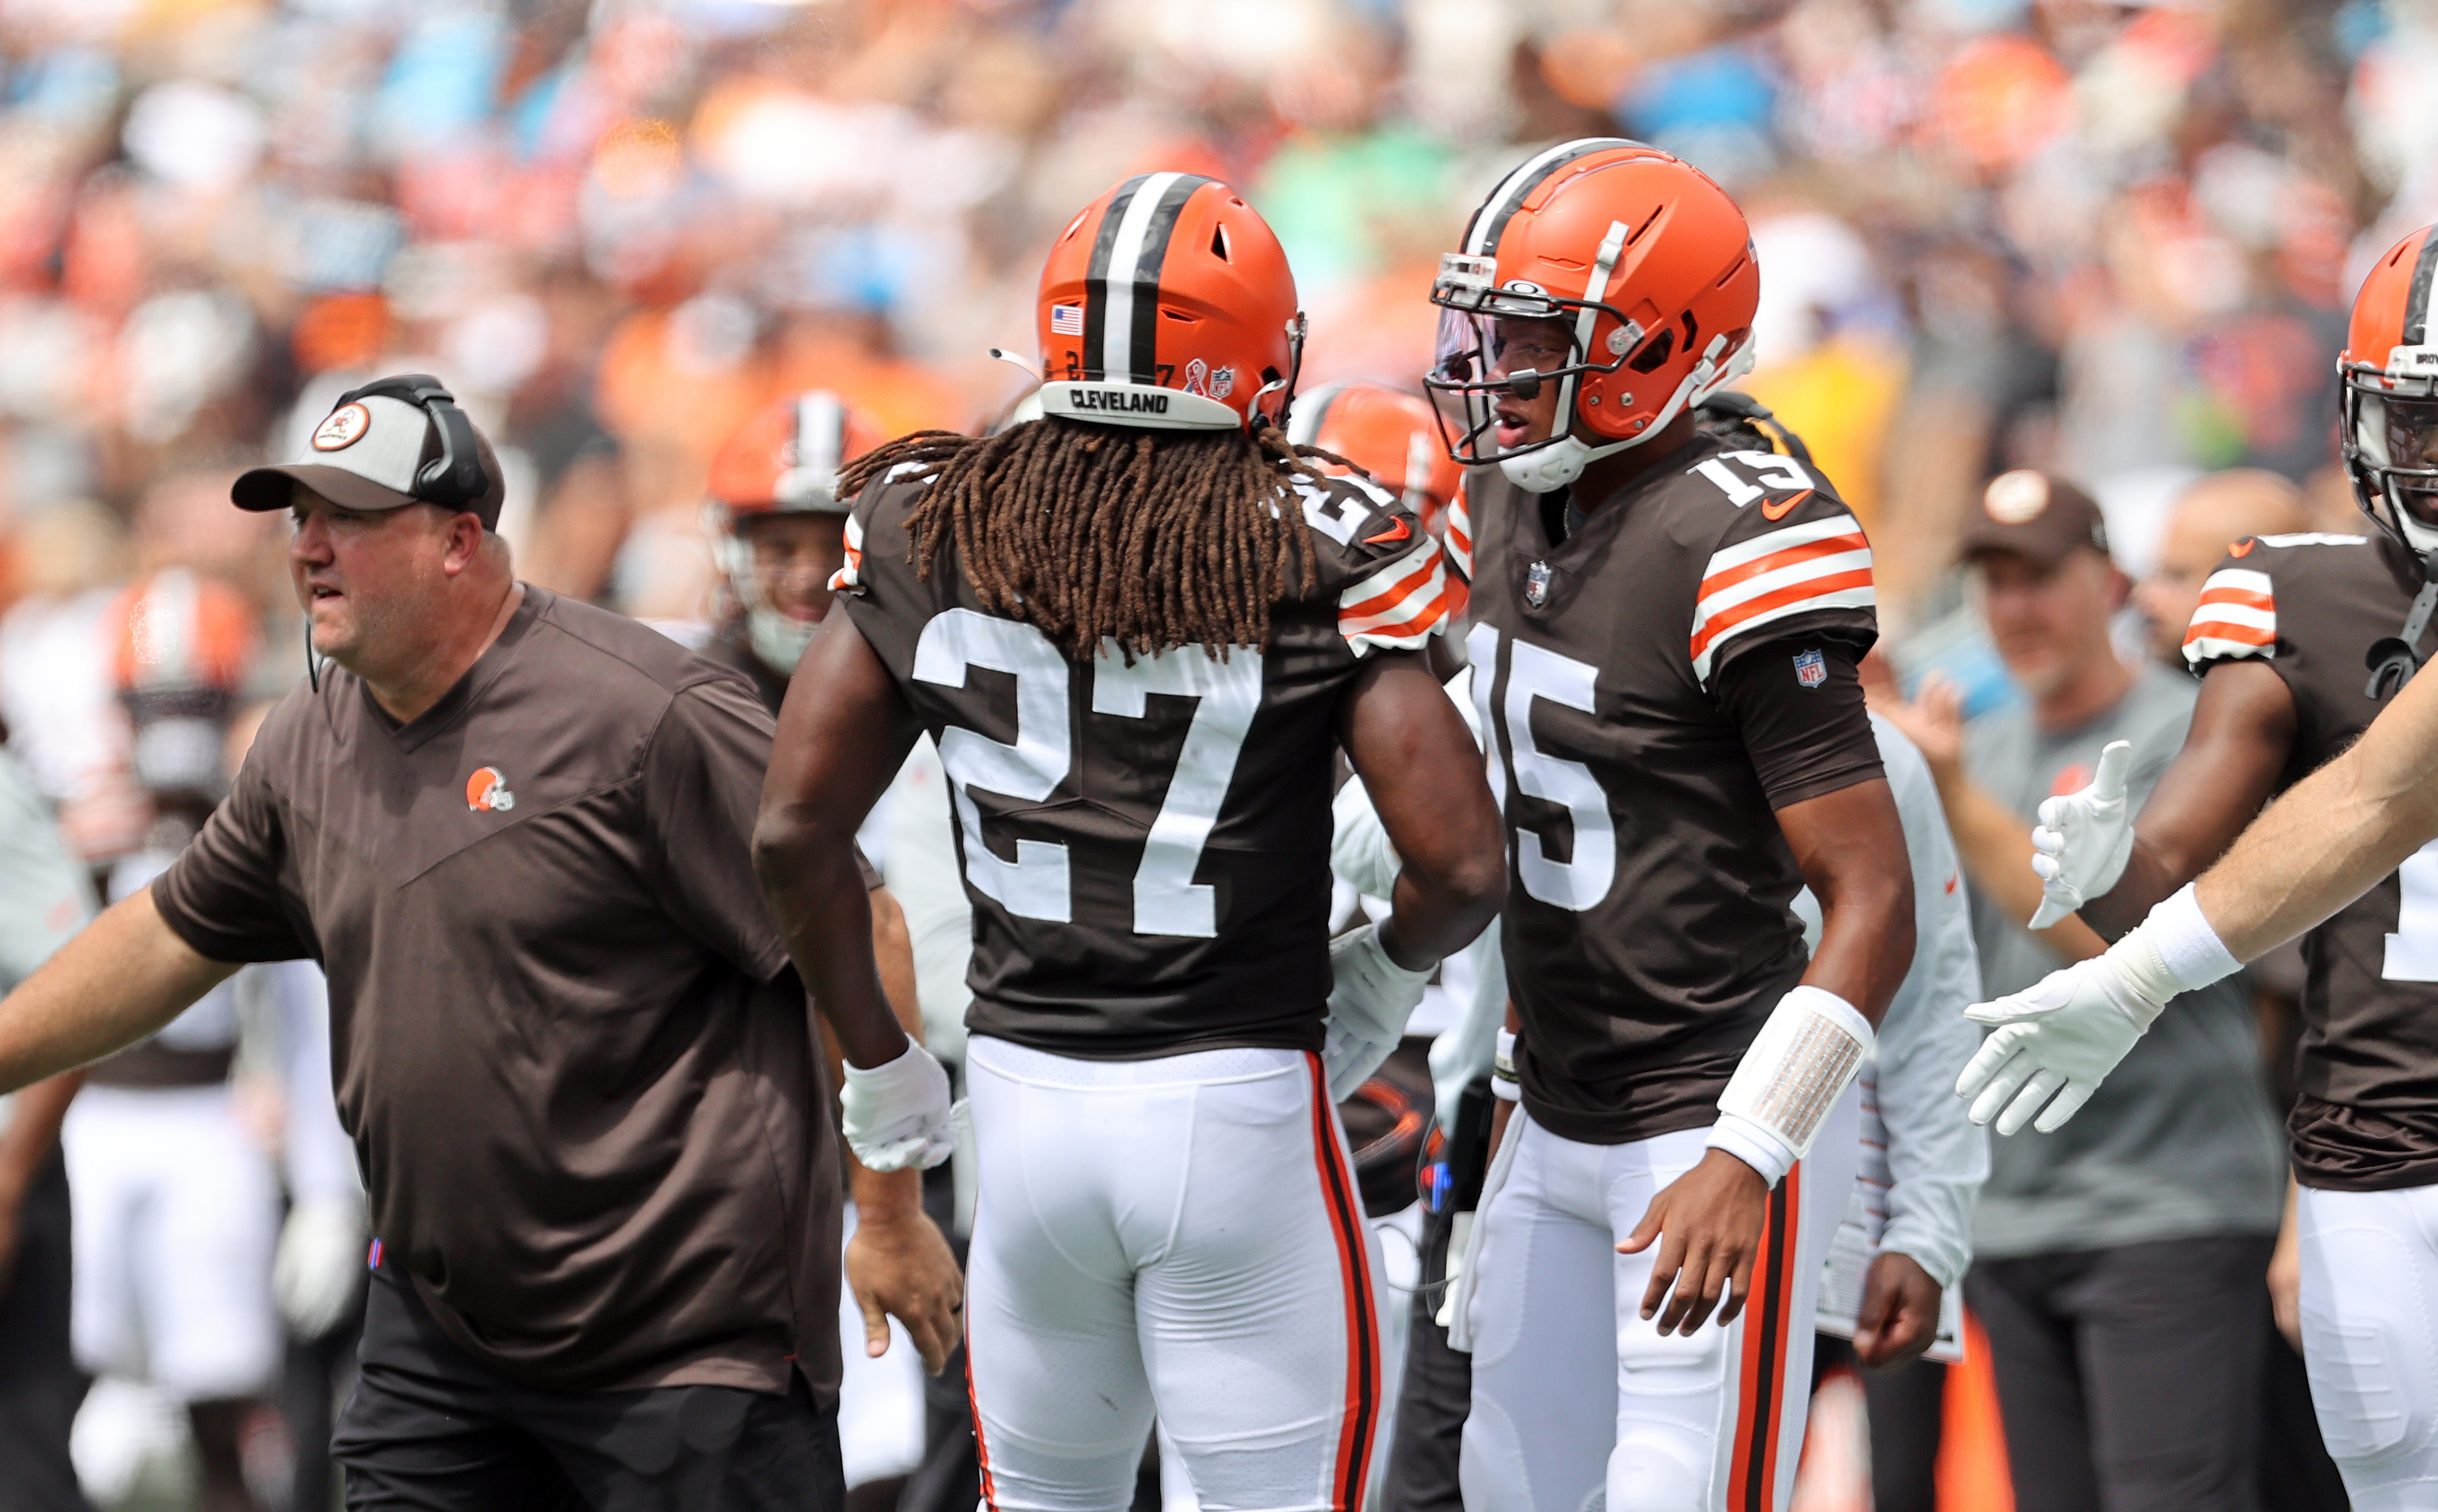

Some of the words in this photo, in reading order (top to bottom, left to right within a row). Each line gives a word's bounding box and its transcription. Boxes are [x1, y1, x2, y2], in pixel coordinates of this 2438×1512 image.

[1070, 389, 1169, 414] CLEVELAND
[1685, 450, 1816, 508] 15
[1800, 664, 1824, 683] NFL
[912, 607, 1264, 939] 27
